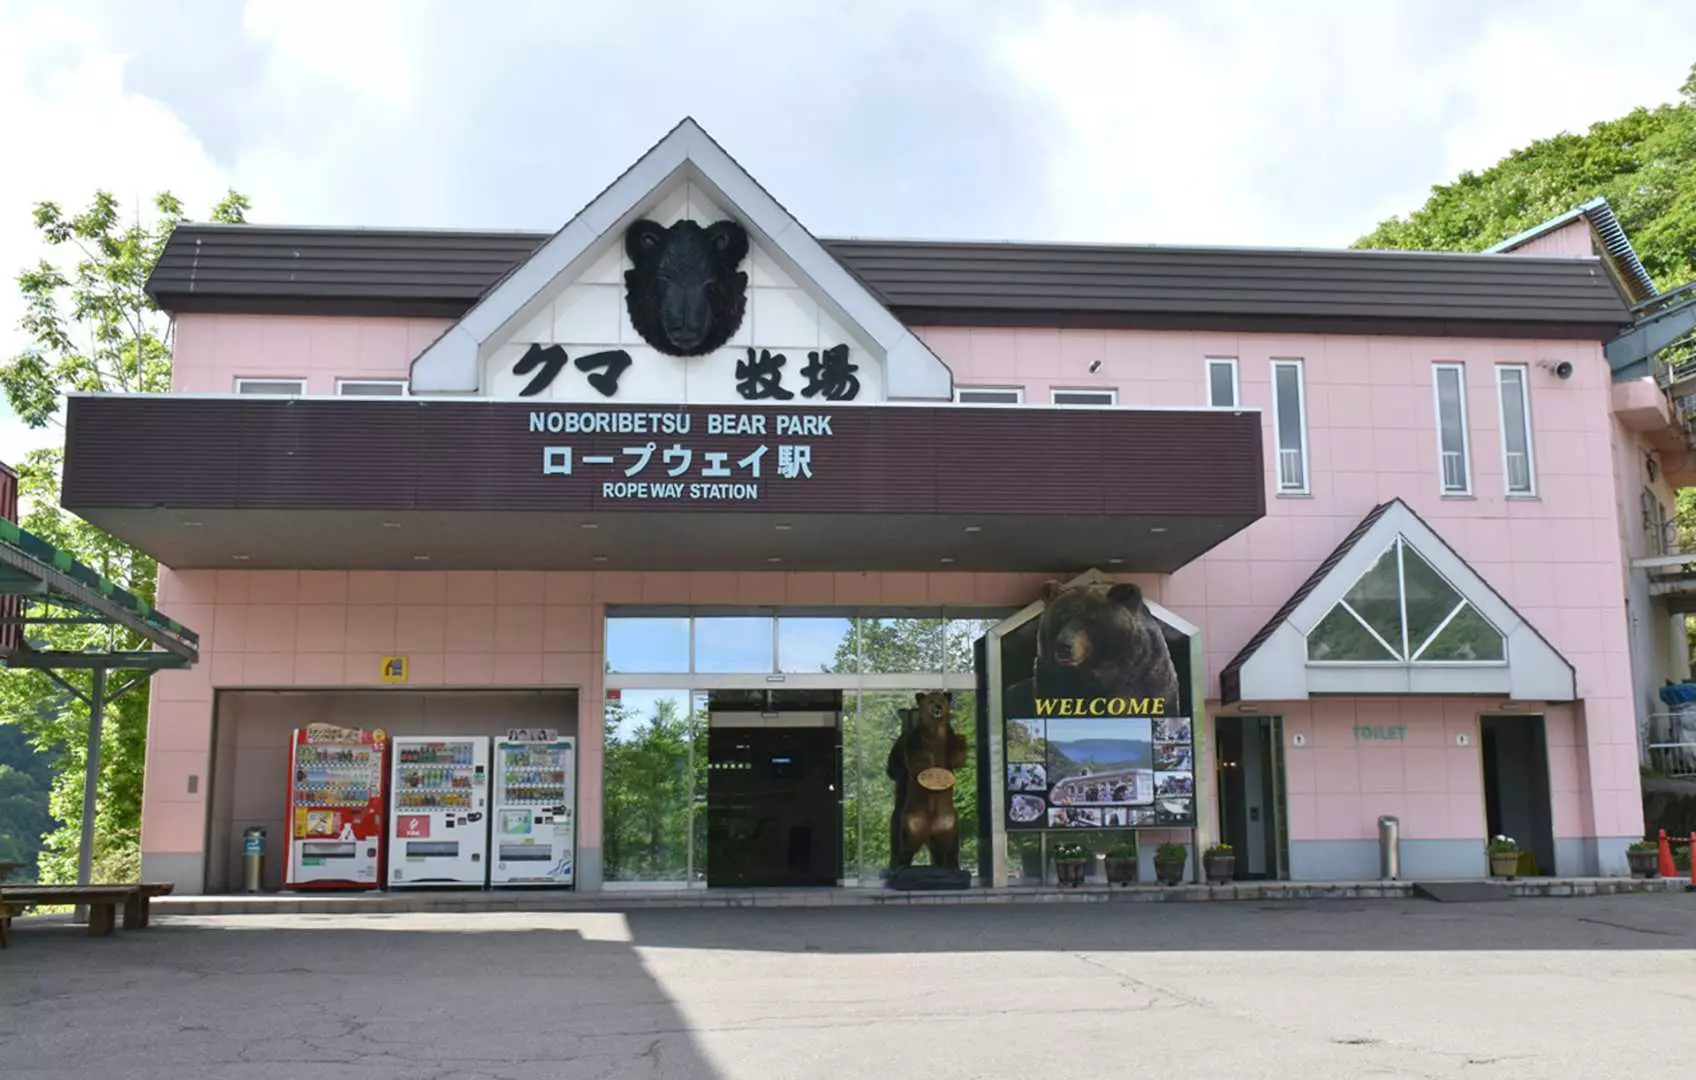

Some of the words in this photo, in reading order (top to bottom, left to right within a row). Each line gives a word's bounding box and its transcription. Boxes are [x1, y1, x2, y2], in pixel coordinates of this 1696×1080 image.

[512, 343, 632, 397] クマ
[736, 343, 860, 401] 牧場
[529, 412, 690, 435] NOBORIBETSU
[707, 414, 766, 435] BEAR
[776, 415, 833, 436] PARK
[543, 442, 813, 479] ロープウェイ駅
[689, 484, 758, 500] STATION
[1034, 697, 1166, 716] WELCOME
[1353, 726, 1406, 740] TOILET
